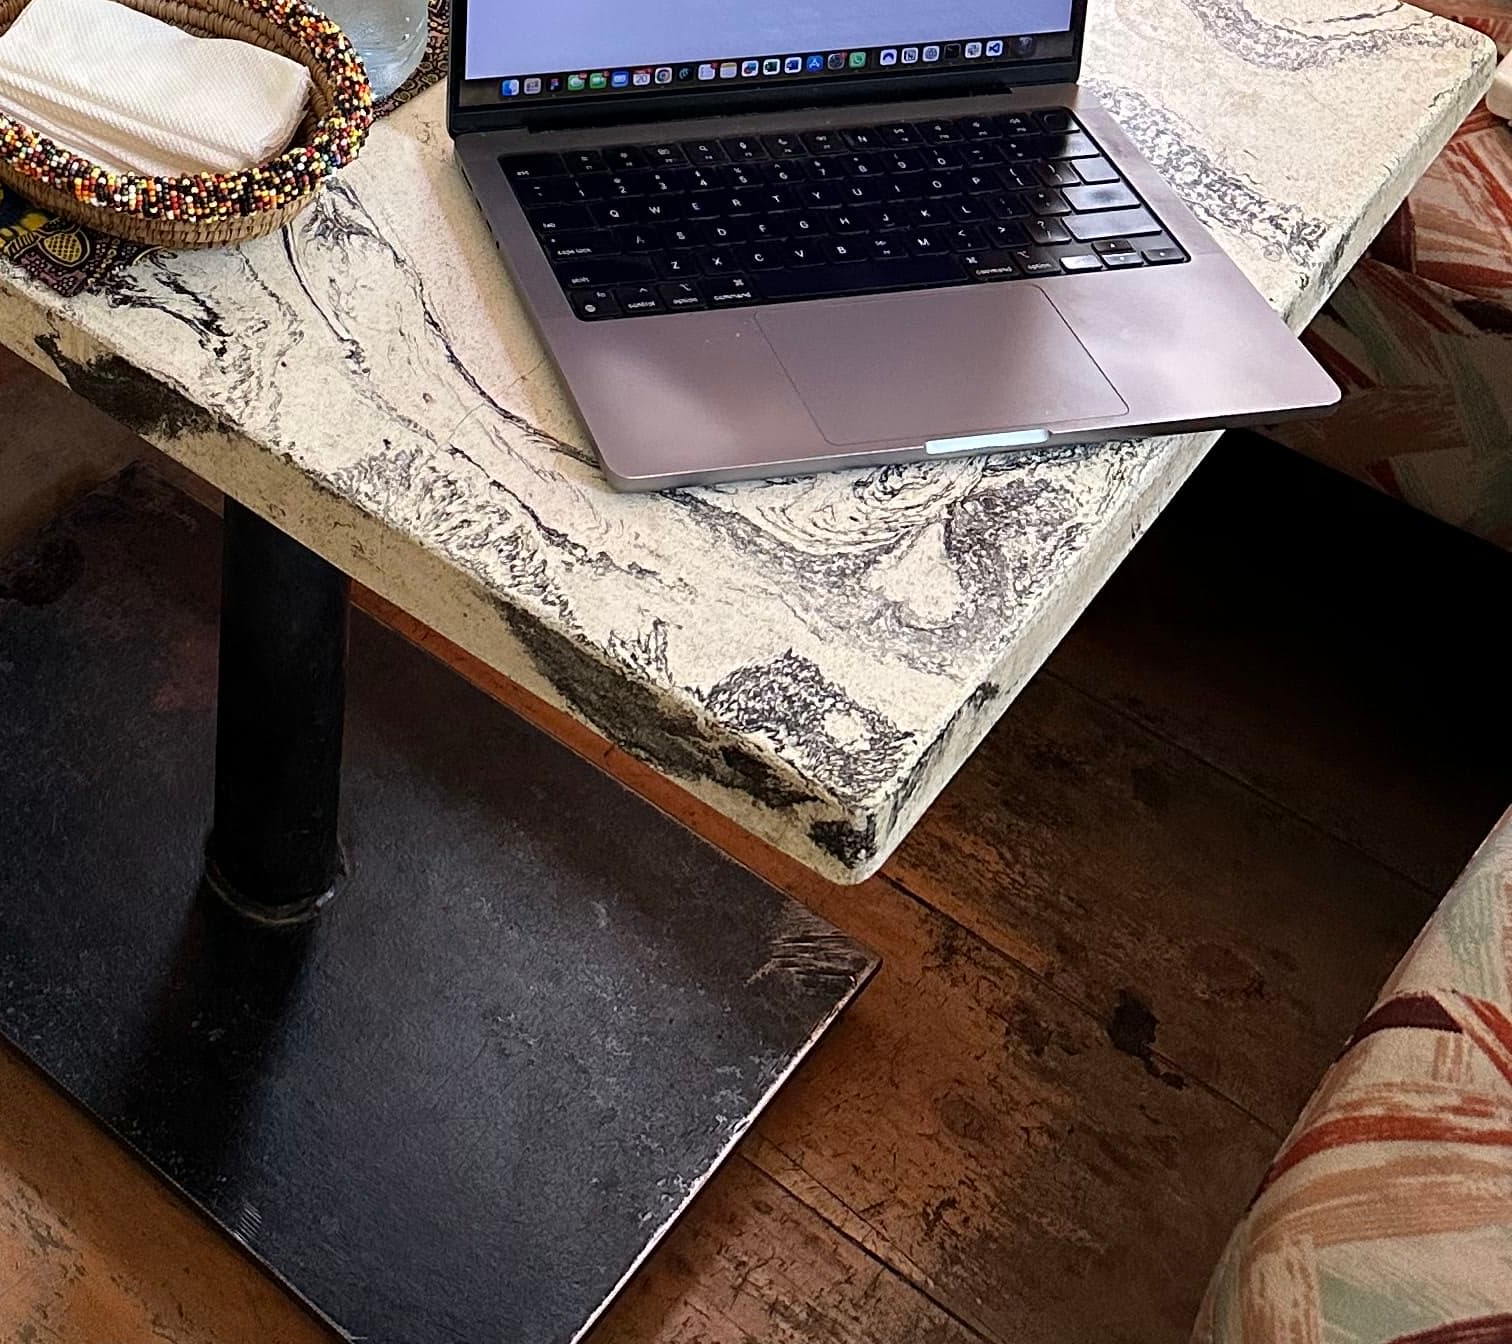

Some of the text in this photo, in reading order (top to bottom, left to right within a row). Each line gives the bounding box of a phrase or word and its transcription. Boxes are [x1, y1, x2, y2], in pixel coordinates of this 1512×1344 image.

[609, 209, 620, 218] Q
[648, 206, 661, 215] W
[691, 202, 701, 211] E
[771, 194, 781, 203] T
[811, 191, 821, 200] Y
[852, 188, 863, 197] U
[716, 227, 727, 236] D
[758, 224, 767, 233] F
[799, 220, 809, 229] G
[670, 261, 681, 270] Z
[711, 257, 723, 266] X
[754, 253, 765, 262] C
[794, 249, 804, 258] V
[836, 245, 847, 255] B
